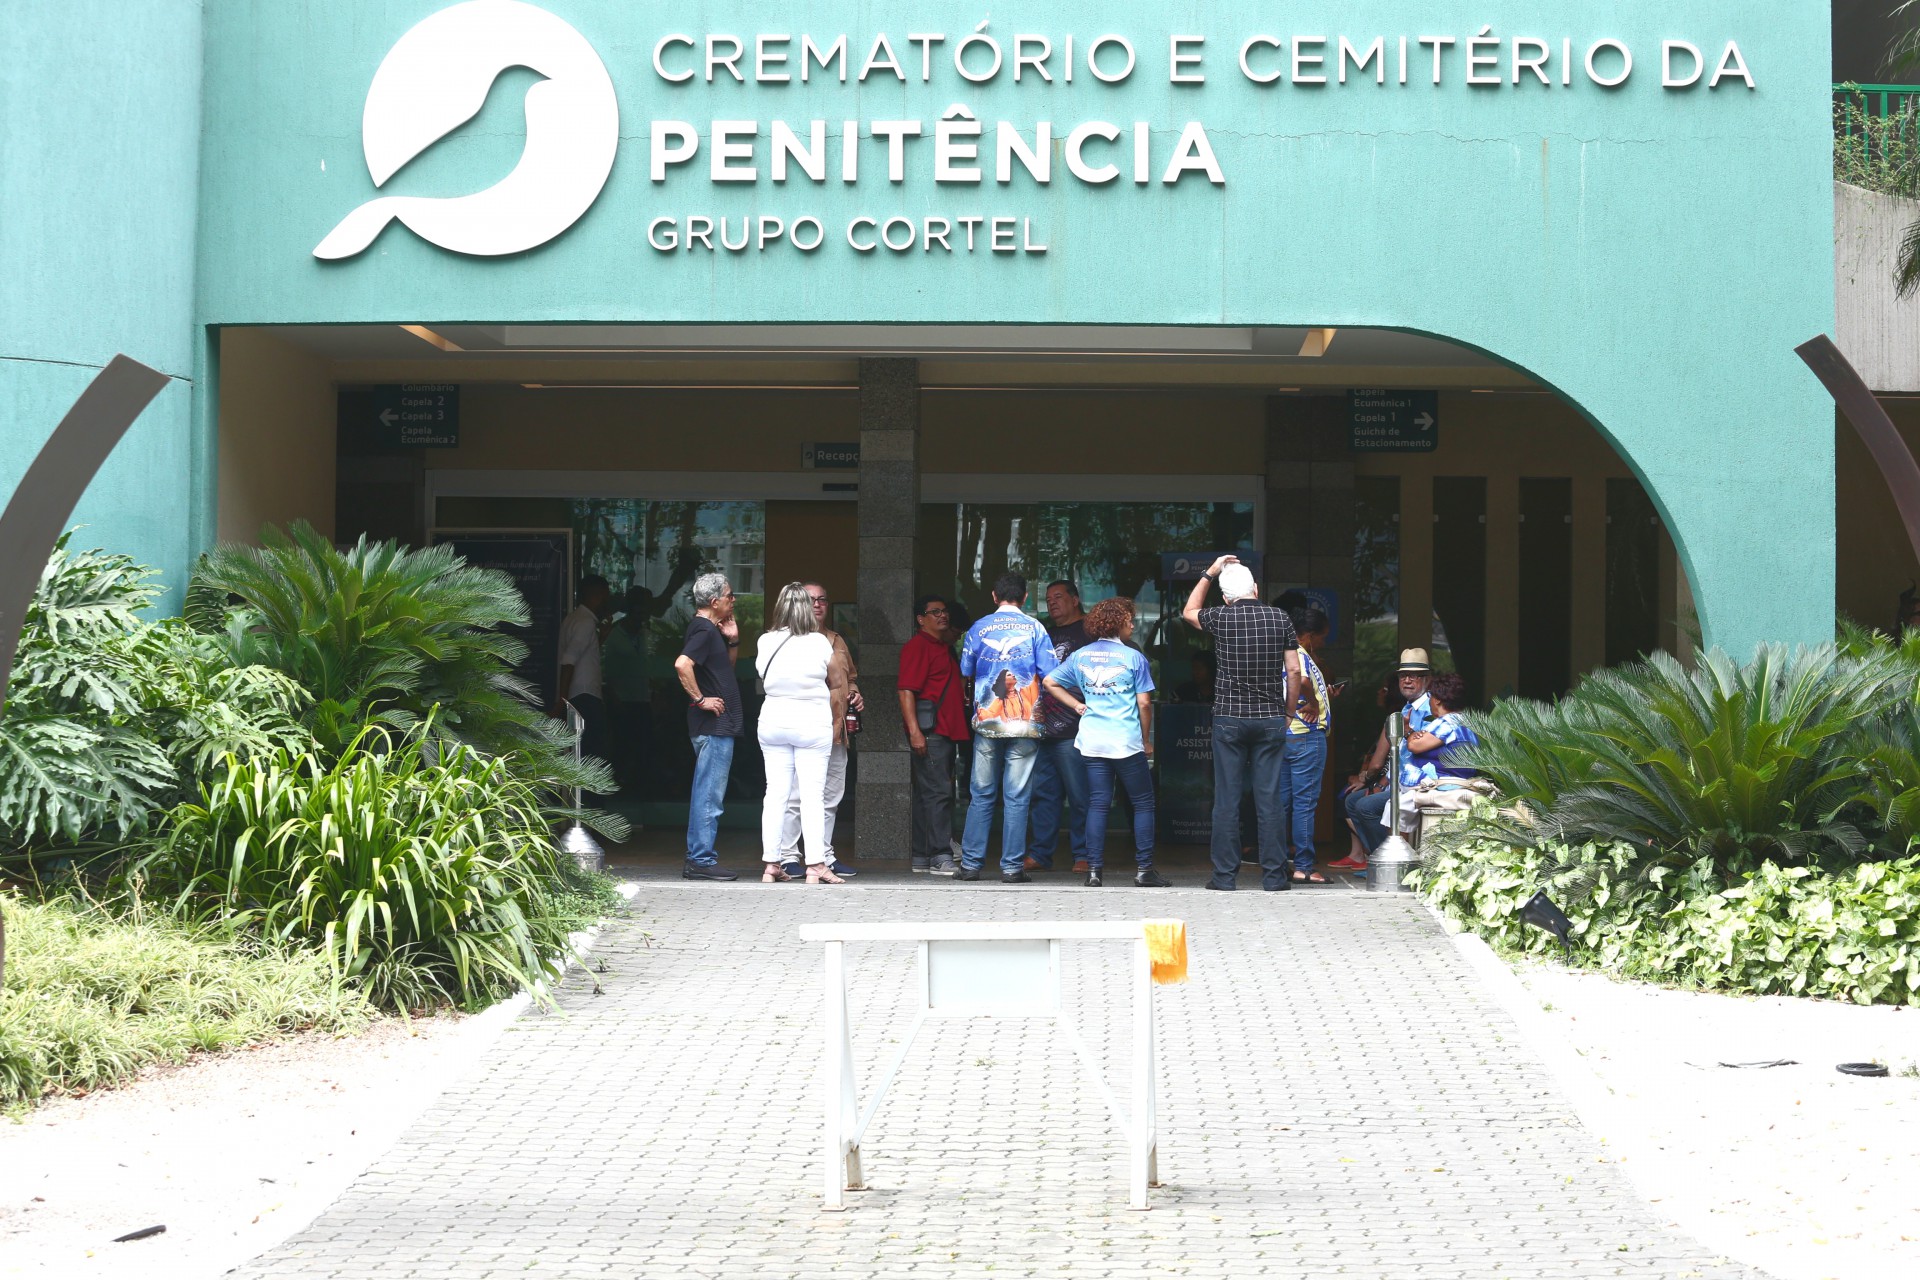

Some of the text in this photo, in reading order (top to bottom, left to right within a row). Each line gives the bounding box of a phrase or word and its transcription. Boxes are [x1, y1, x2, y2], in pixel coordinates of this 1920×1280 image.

[652, 18, 1756, 89] CREMATÓRIO E CEMITÉRIO DA
[650, 103, 1226, 184] PENITÊNCIA
[647, 215, 1048, 252] GRUPO CORTEL
[1354, 388, 1386, 397] Capela
[401, 395, 445, 407] Capela 2
[401, 410, 444, 422] Capela 3
[1354, 411, 1396, 423] Capela 1
[401, 426, 432, 436] Capela
[1388, 427, 1400, 436] de
[450, 435, 456, 444] 2
[1354, 438, 1432, 447] Estacionamento
[817, 450, 859, 463] Recepç
[978, 623, 1035, 637] COMPOSITORES
[1194, 726, 1213, 735] PLA
[1176, 738, 1211, 748] ASSIST
[1188, 751, 1213, 760] FAMI
